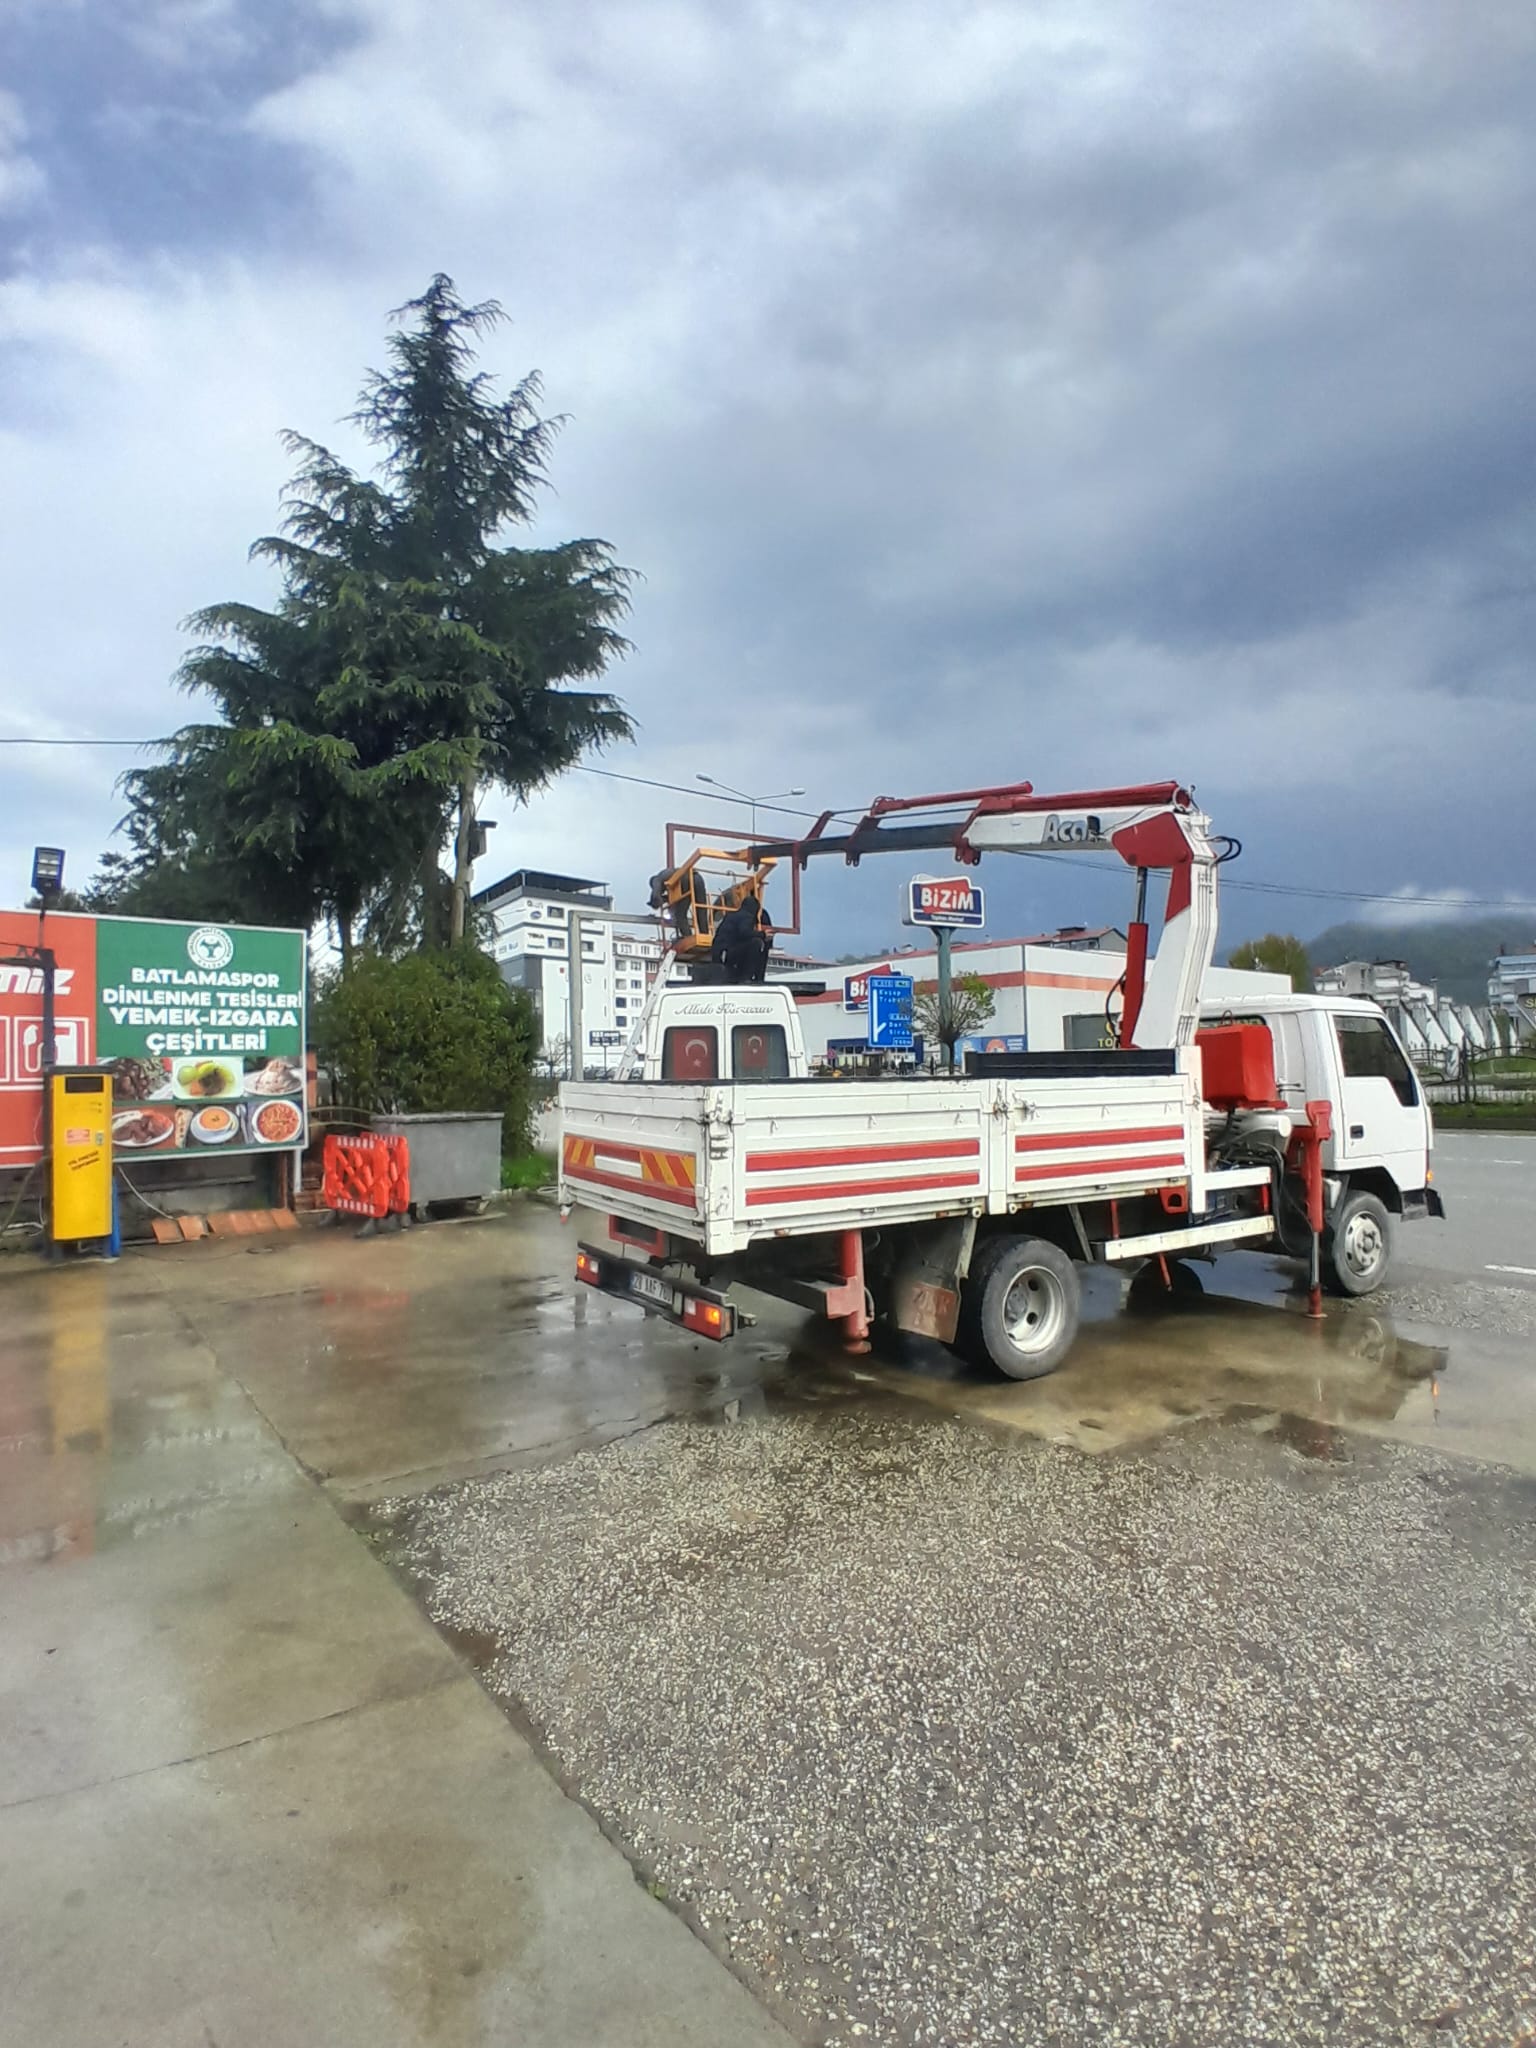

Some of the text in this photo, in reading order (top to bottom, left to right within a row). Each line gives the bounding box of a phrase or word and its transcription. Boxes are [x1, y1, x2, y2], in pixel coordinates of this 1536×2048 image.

[131, 967, 280, 988] BATLAMASPOR
[102, 985, 302, 1009] DİNLENME TESİSLERİ
[110, 1007, 299, 1027] YEMEK-IZGARA
[145, 1028, 267, 1055] ÇEŞİTLERİ
